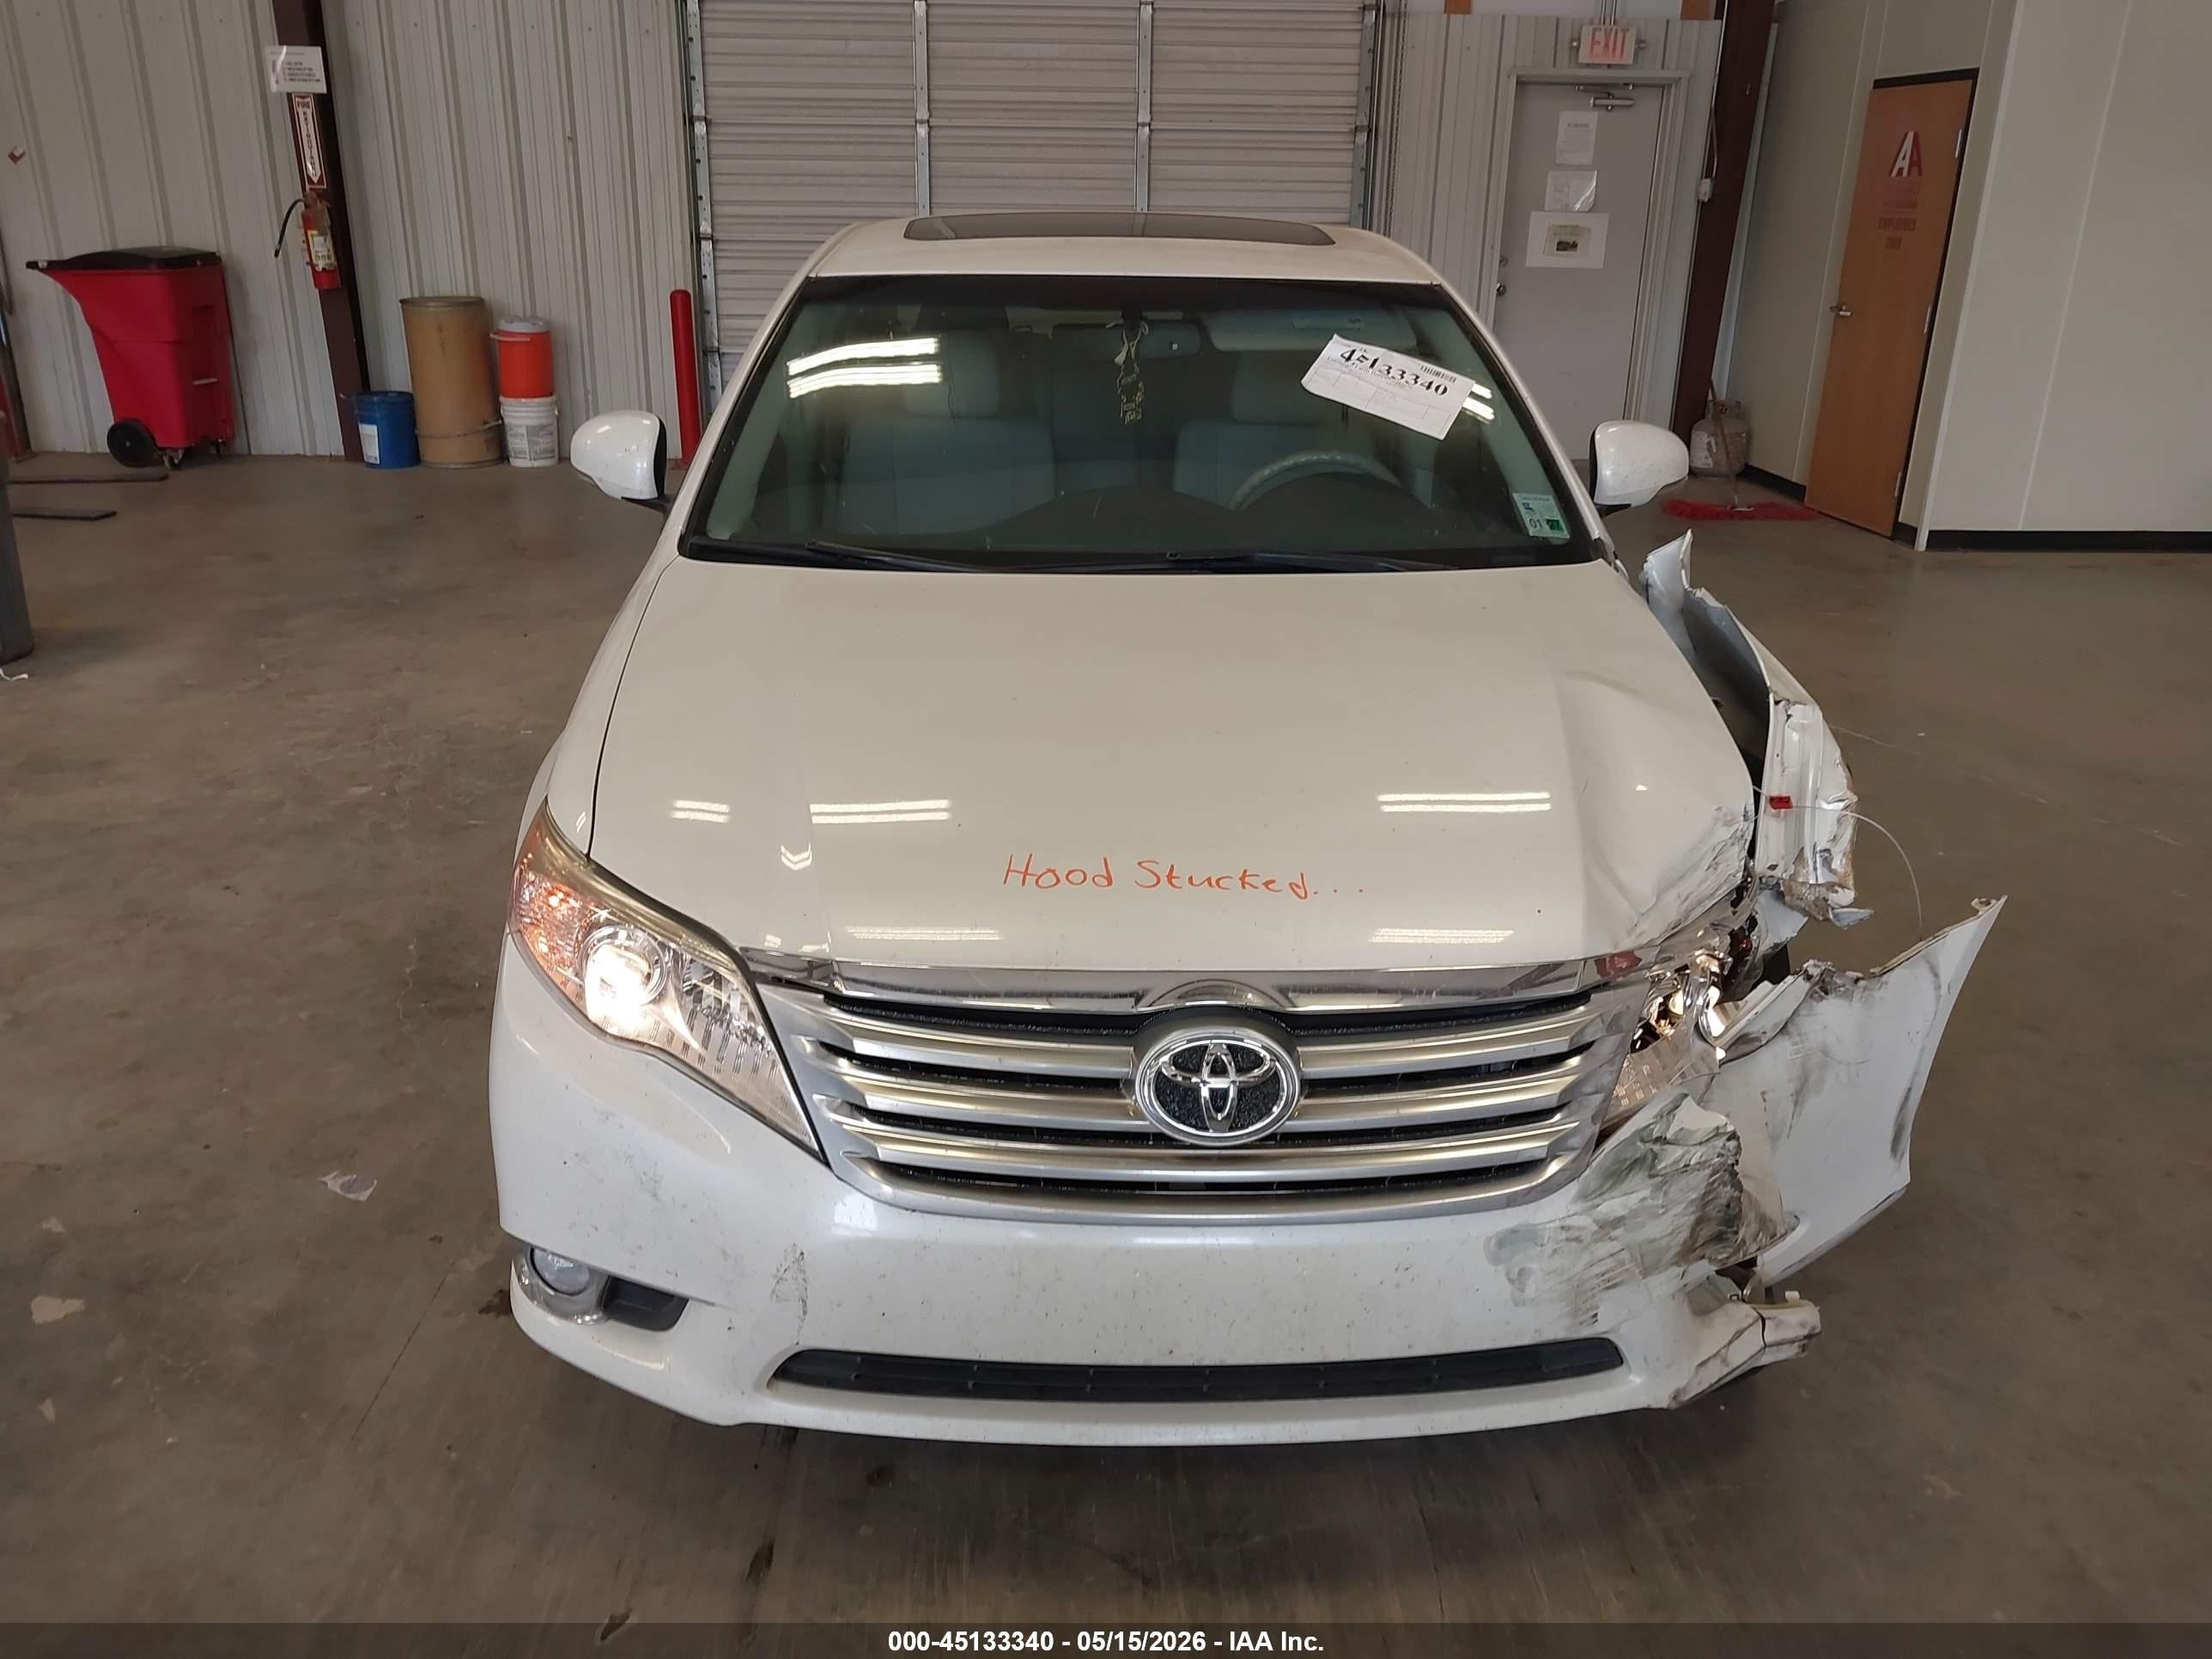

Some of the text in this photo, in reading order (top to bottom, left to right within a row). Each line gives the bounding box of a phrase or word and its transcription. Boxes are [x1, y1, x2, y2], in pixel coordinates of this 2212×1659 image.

[1589, 27, 1630, 58] EXIT
[296, 100, 311, 109] FIRE
[1340, 348, 1448, 396] 45133340
[1528, 518, 1543, 529] 01
[1004, 853, 1114, 890] Hood
